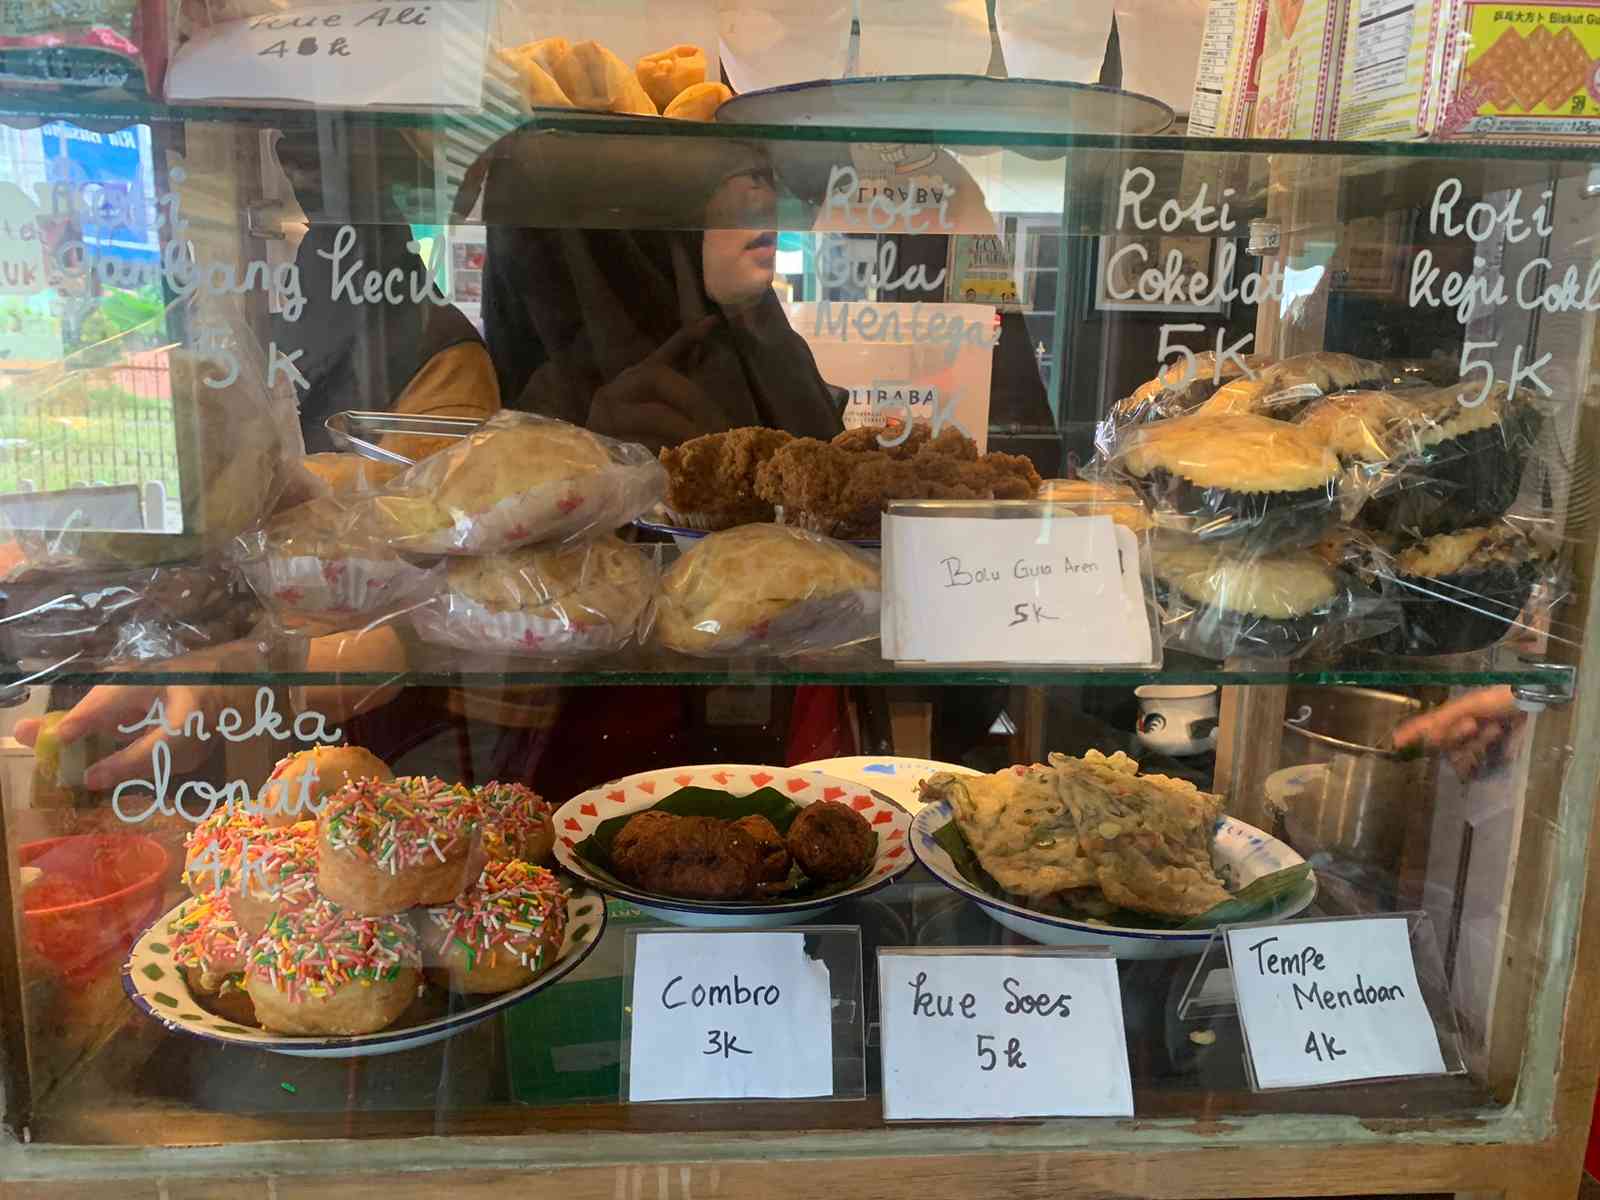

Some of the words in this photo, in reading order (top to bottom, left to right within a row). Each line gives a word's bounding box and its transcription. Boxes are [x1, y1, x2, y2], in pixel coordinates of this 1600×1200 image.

[354, 5, 431, 27] Ali
[825, 164, 957, 232] Roti
[1116, 166, 1237, 232] Roti
[1429, 177, 1553, 243] Roti
[1107, 242, 1285, 305] Cokelat
[1064, 556, 1100, 574] Aren
[118, 686, 342, 742] Aneka
[1249, 936, 1326, 976] Tempe
[662, 975, 780, 1009] Combro
[1003, 977, 1073, 1018] Soes
[1293, 974, 1404, 1010] Mendoan
